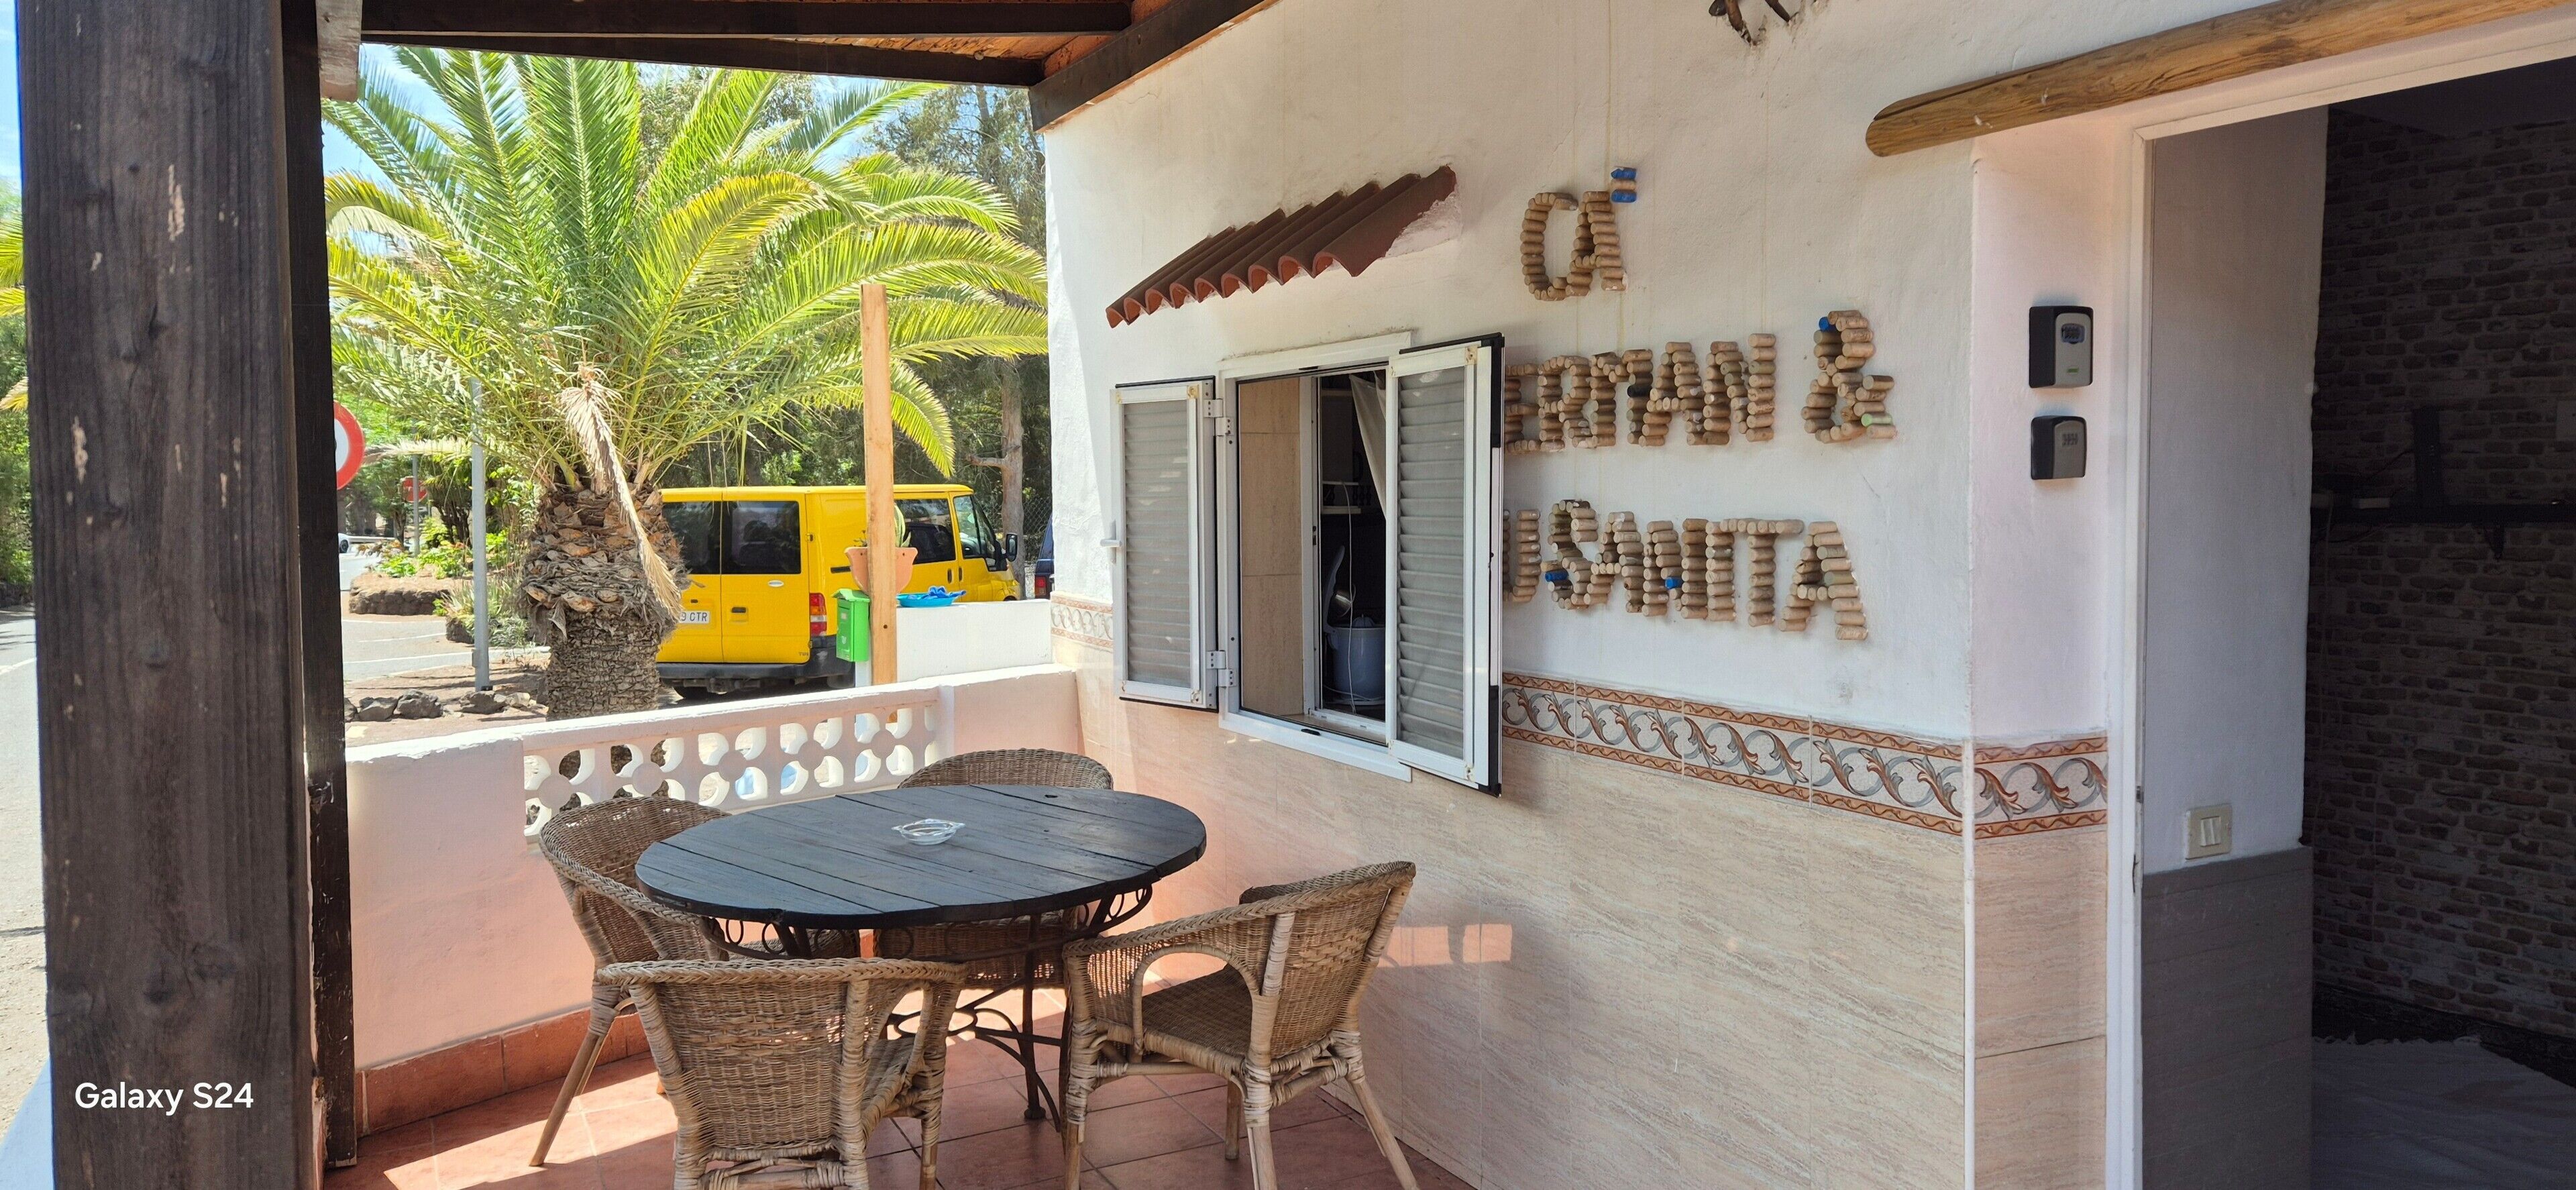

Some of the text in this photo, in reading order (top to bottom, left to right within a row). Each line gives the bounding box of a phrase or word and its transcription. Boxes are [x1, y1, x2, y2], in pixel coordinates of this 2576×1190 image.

[1504, 310, 1896, 455] ERMAN &
[690, 612, 708, 622] CTR
[1503, 499, 1868, 641] USANITA
